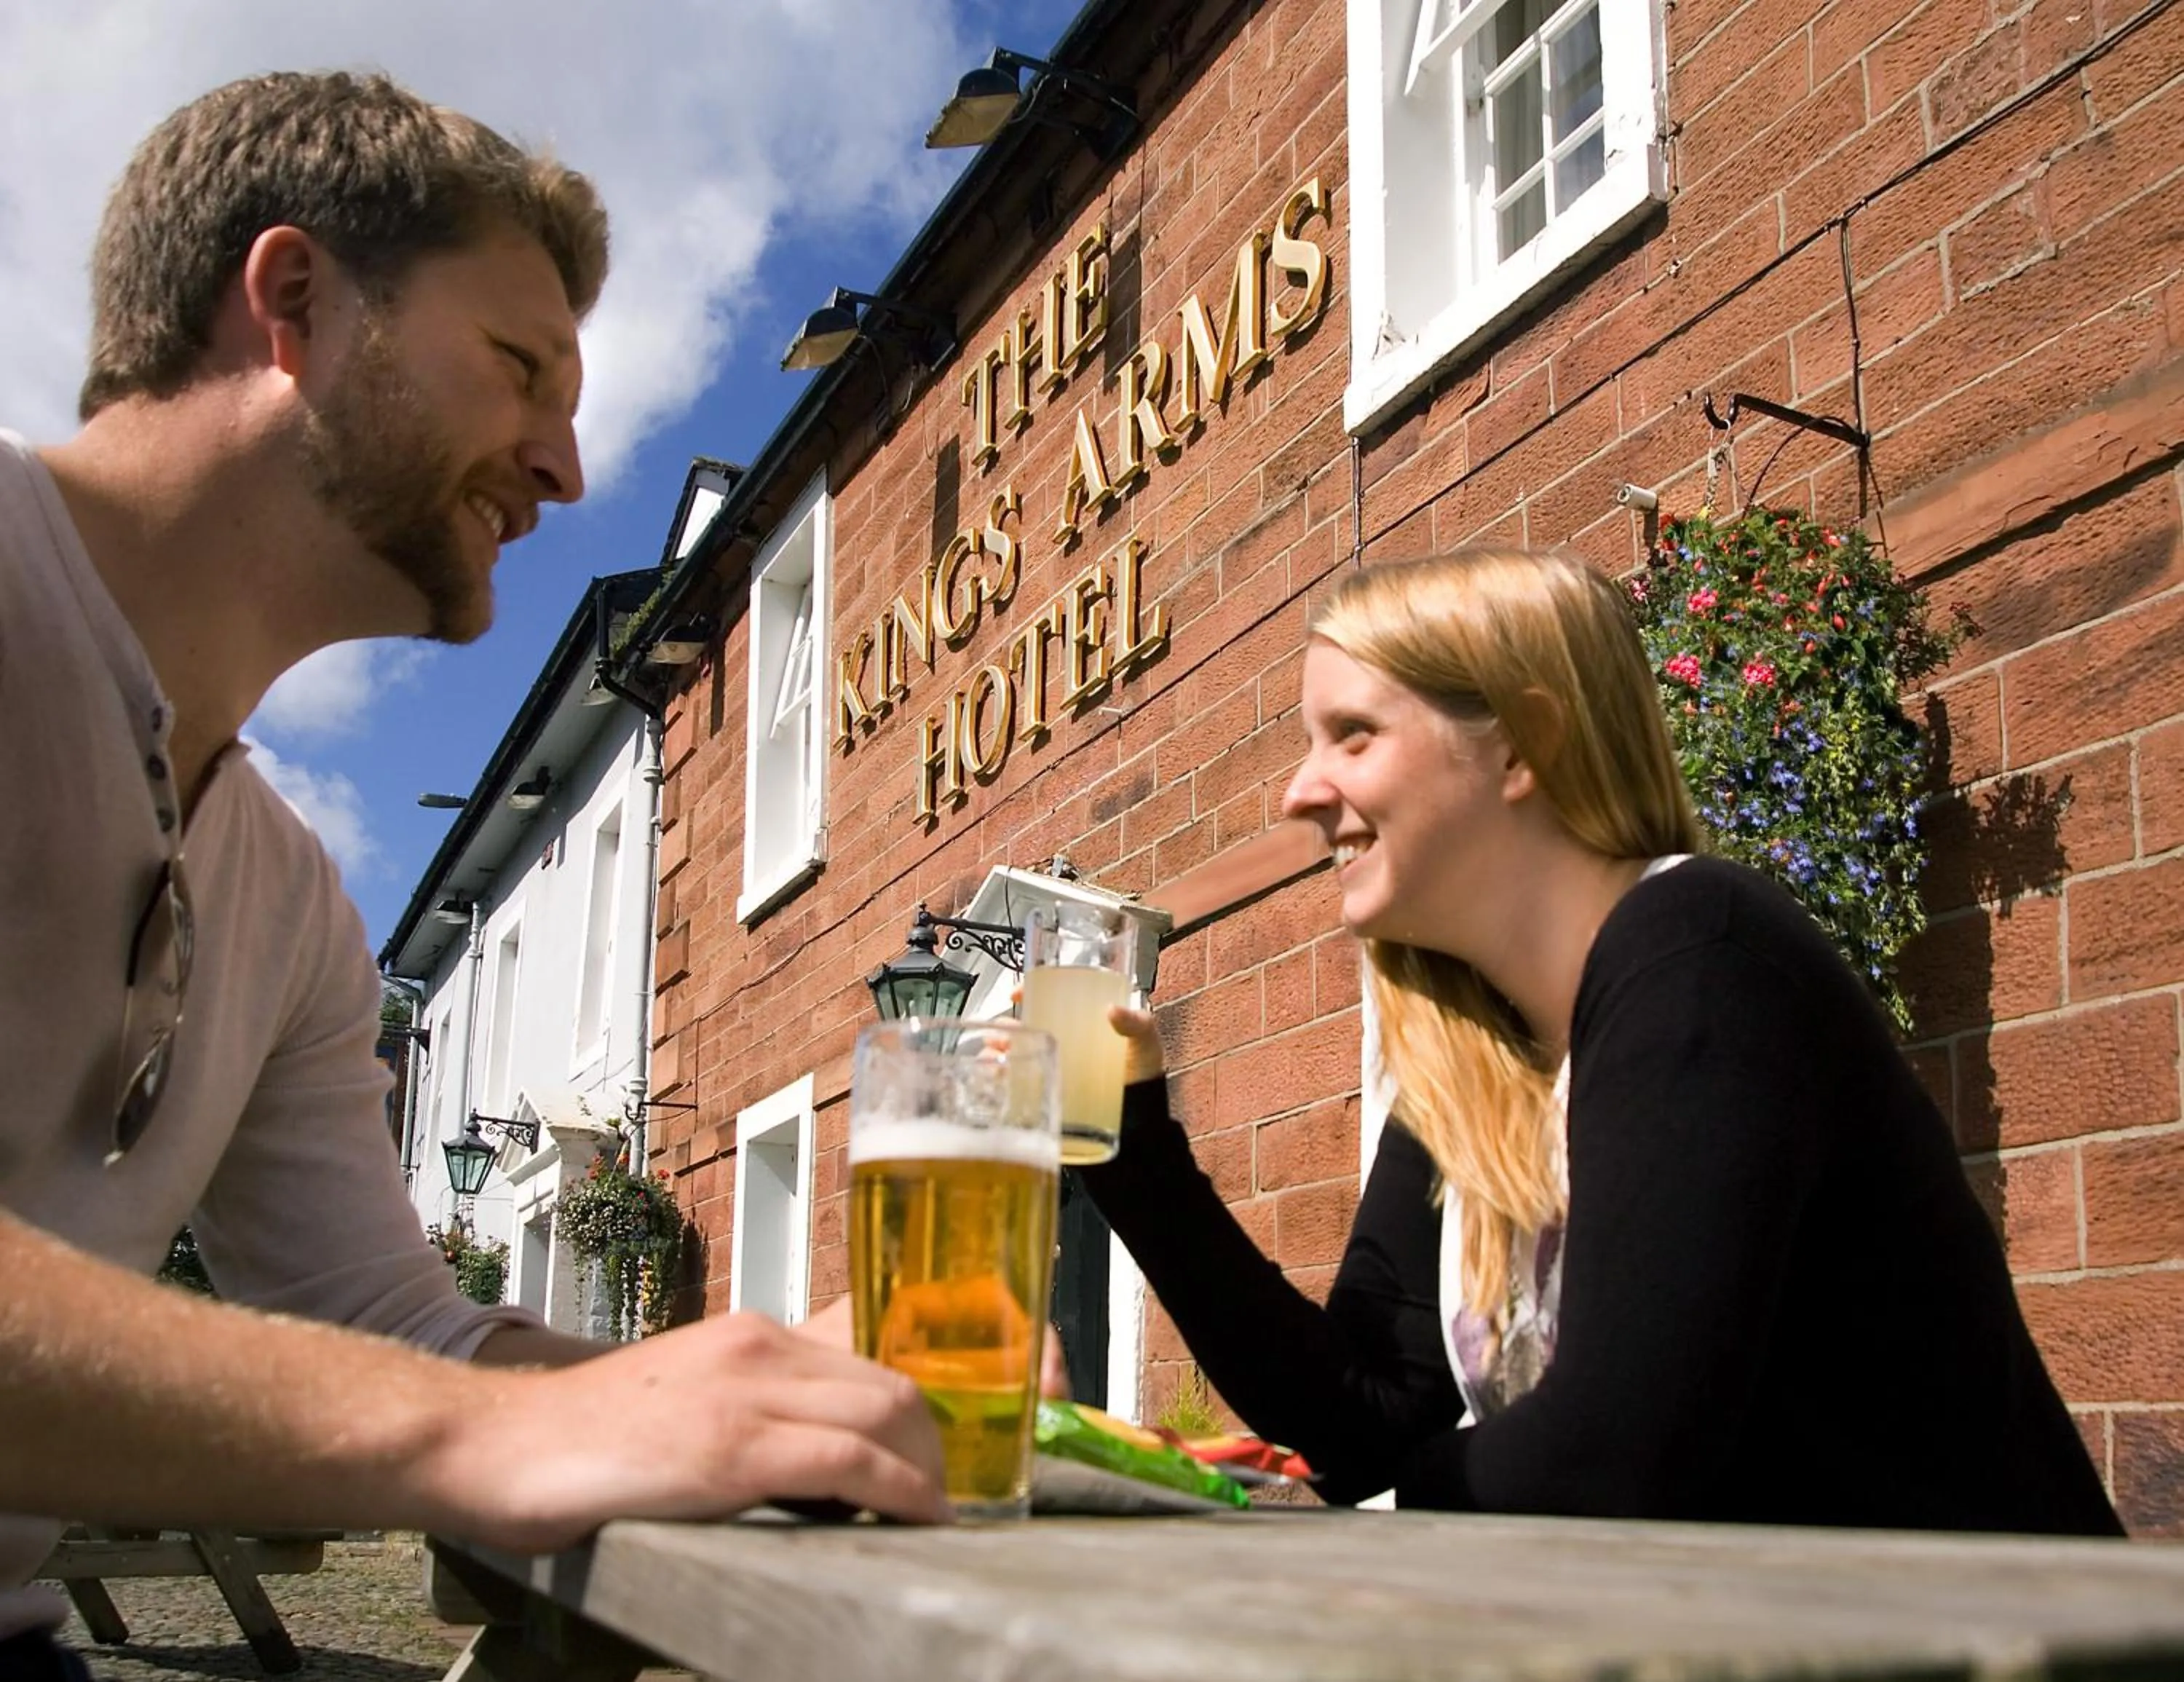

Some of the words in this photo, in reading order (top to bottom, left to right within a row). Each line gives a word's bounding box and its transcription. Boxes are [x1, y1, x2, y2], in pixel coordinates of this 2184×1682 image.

[834, 484, 1021, 750] KINGS
[1053, 178, 1328, 542] ARMS
[962, 223, 1108, 466] THE
[912, 537, 1169, 824] HOTEL
